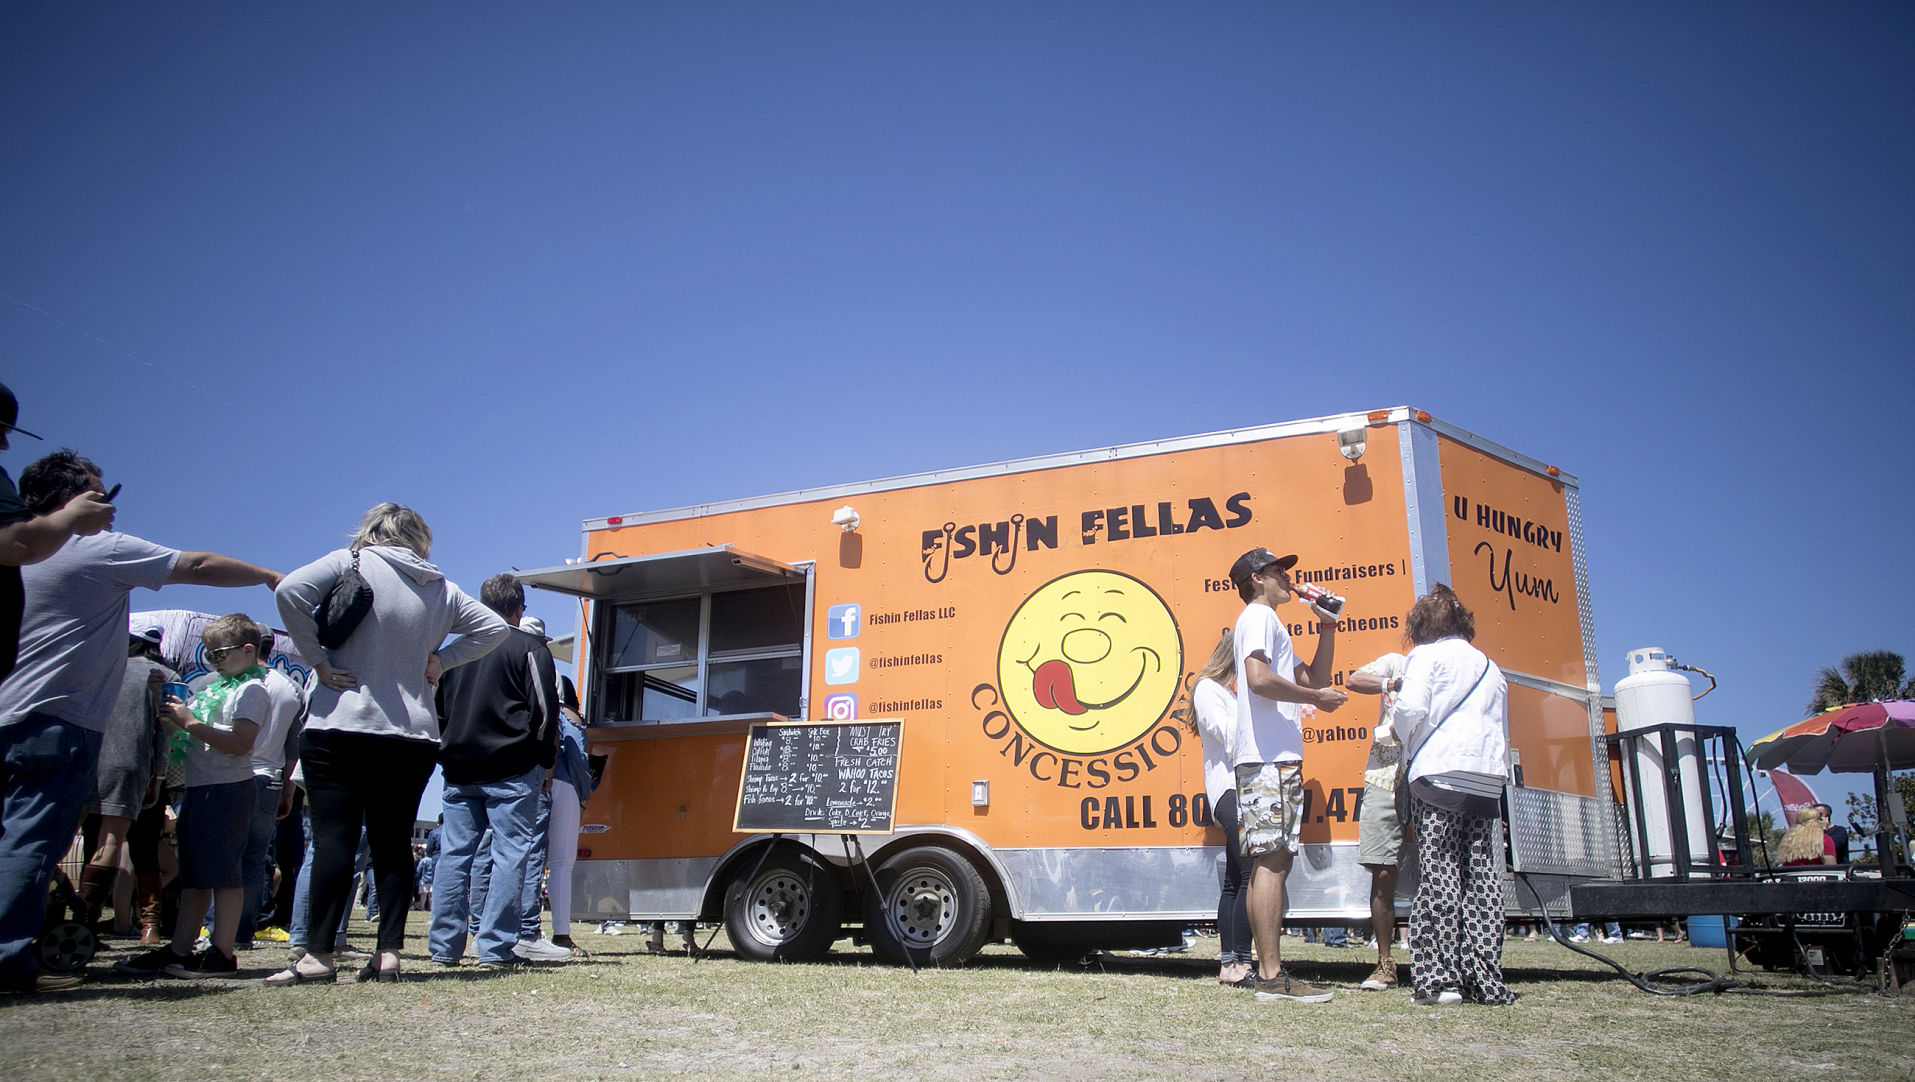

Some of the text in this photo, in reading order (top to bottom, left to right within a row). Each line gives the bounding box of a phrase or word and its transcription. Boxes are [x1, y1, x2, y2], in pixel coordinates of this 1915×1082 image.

[1082, 492, 1252, 545] FELLAS
[1454, 496, 1562, 553] U HUNGRY
[1295, 563, 1395, 585] Fundraisers
[1474, 541, 1559, 611] Yum
[869, 606, 956, 625] Fishin Fellas LLC
[869, 653, 943, 669] @fishinfellas
[868, 698, 943, 713] @fishinfellas
[850, 737, 896, 747] CRAB FRIES
[834, 755, 892, 767] FRESH CATCH
[789, 772, 797, 783] 2
[799, 772, 811, 783] for
[838, 767, 895, 779] WAHOO TACOS
[838, 782, 847, 793] 2
[850, 780, 862, 794] for
[784, 795, 792, 806] 2
[795, 793, 805, 806] for
[826, 797, 857, 808] Lemonade
[1080, 795, 1157, 830] CALL
[1168, 793, 1210, 828] 80
